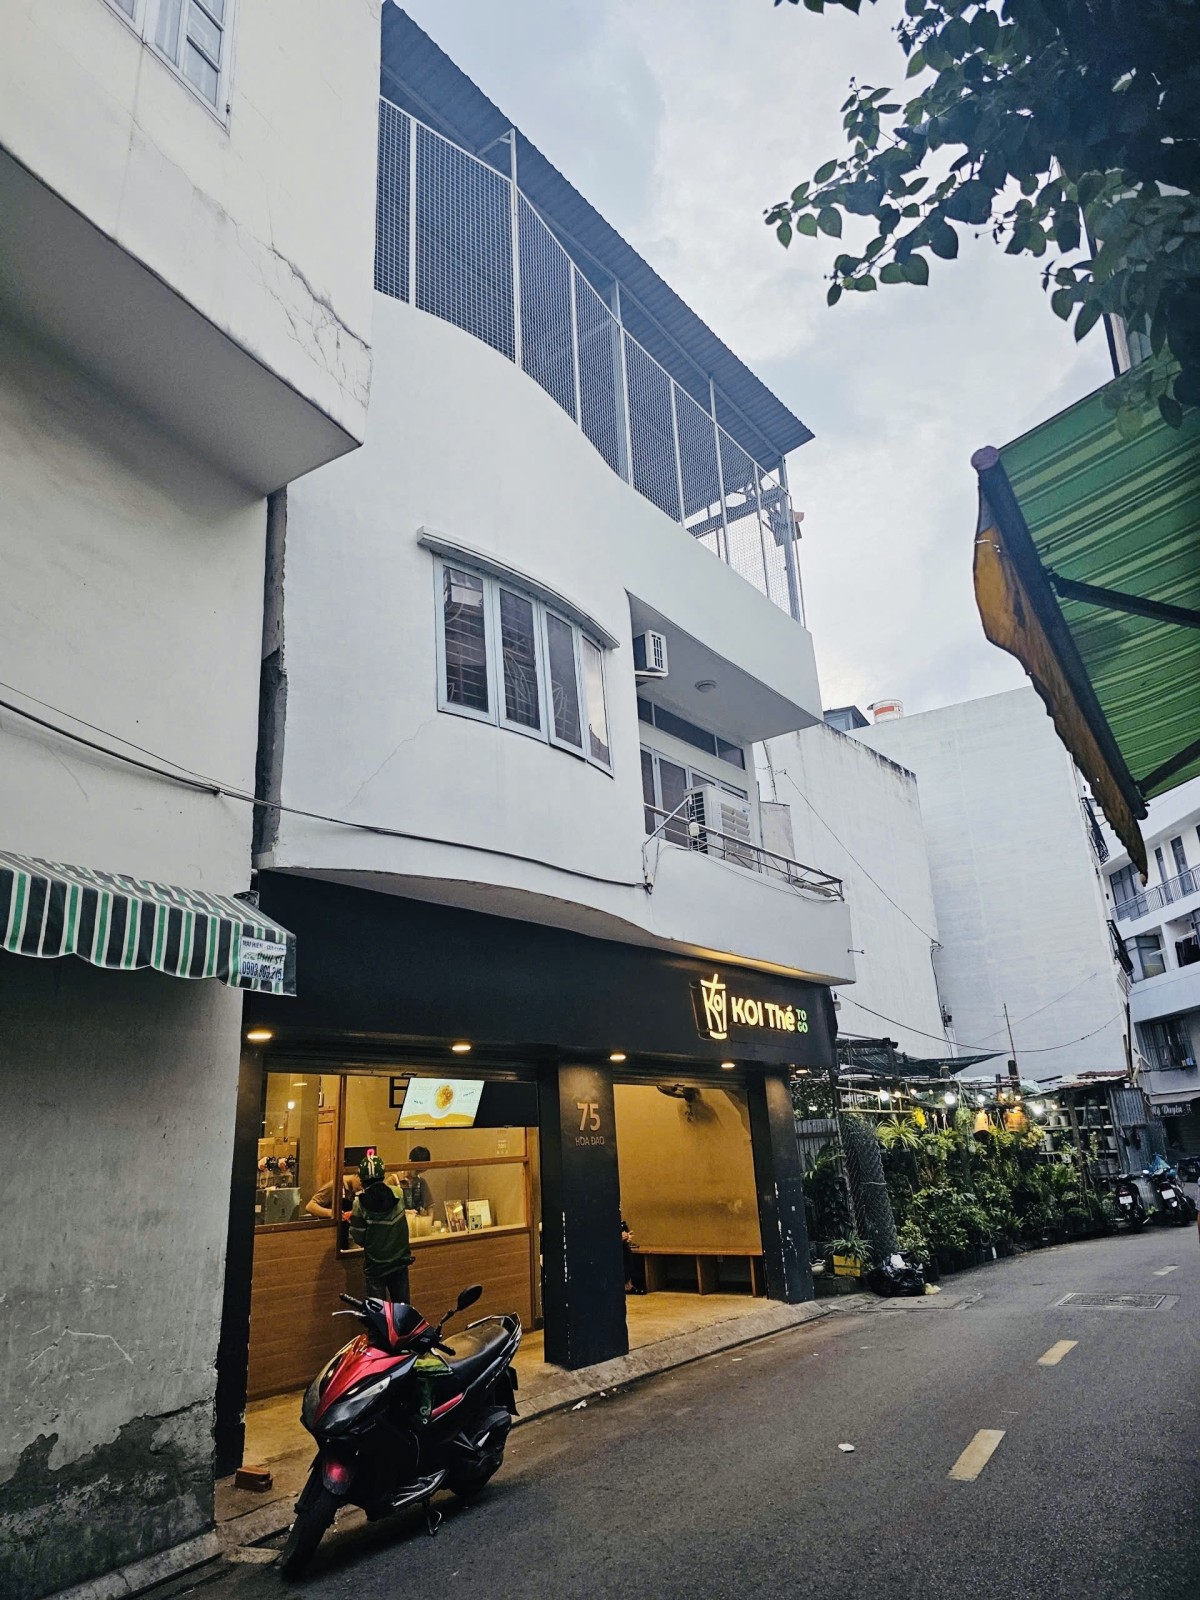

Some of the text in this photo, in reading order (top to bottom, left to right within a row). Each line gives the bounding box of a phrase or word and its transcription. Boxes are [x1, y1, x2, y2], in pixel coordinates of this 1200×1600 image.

[731, 996, 795, 1032] KOI Thé
[796, 1008, 807, 1021] TO
[797, 1021, 809, 1034] GO
[576, 1102, 601, 1131] 75
